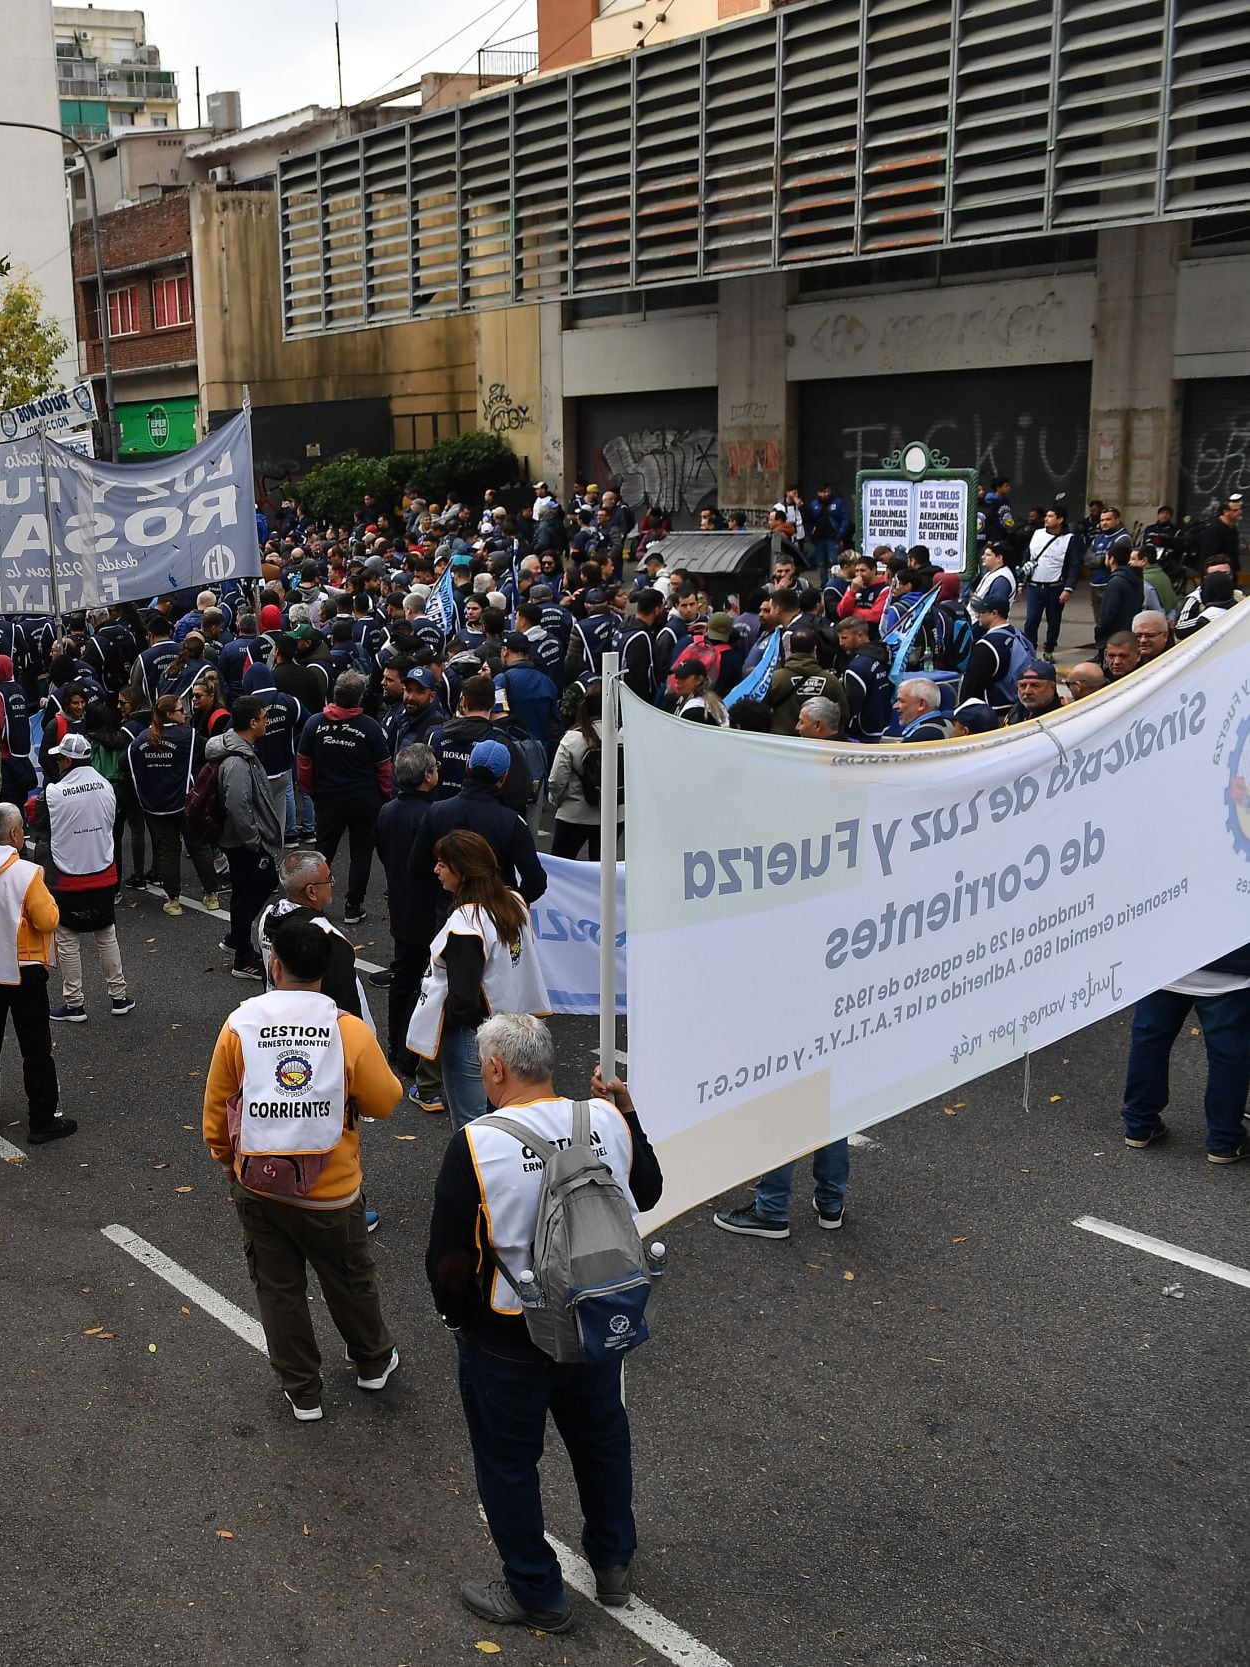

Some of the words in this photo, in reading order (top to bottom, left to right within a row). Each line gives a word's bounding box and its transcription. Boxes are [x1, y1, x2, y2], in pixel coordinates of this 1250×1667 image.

[18, 392, 71, 424] BONJOUR
[870, 488, 883, 498] LOS
[885, 488, 909, 498] CIELOS
[920, 490, 933, 500] LOS
[936, 490, 960, 500] CIELOS
[869, 519, 908, 528] ARGENTINAS
[918, 522, 959, 531] ARGENTINAS
[869, 528, 877, 537] SE
[878, 529, 907, 538] DEFIENDE
[918, 531, 926, 540] SE
[928, 532, 958, 541] DEFIENDE
[316, 724, 330, 735] Luz
[342, 723, 366, 739] Fuerza
[323, 735, 356, 748] Rosario
[259, 1025, 330, 1039] GESTION
[257, 1040, 293, 1049] ERNESTO
[249, 1100, 331, 1119] CORRIENTES
